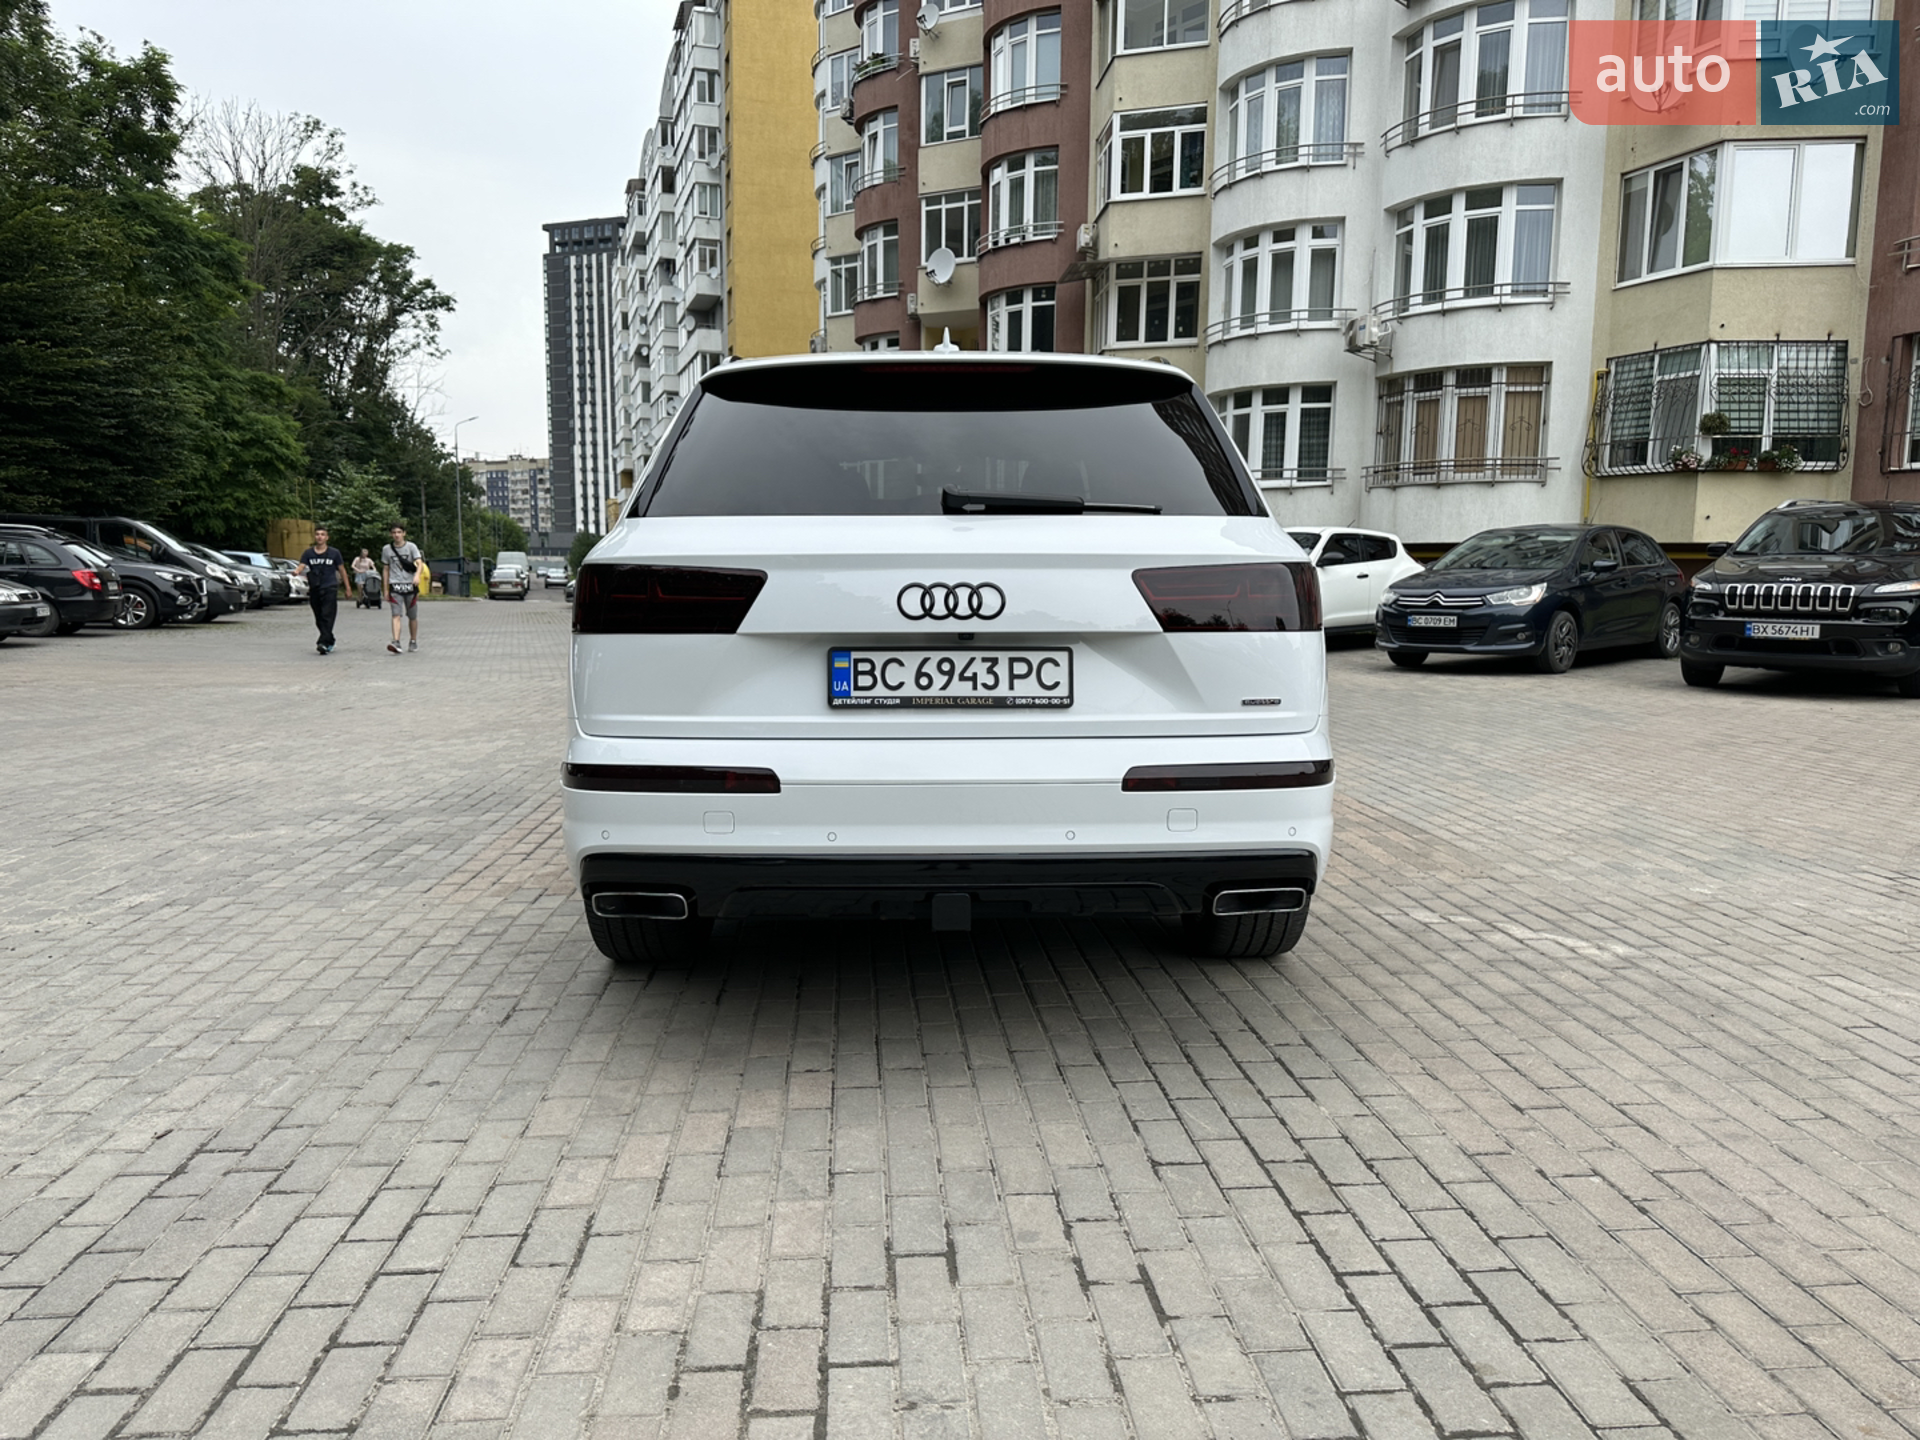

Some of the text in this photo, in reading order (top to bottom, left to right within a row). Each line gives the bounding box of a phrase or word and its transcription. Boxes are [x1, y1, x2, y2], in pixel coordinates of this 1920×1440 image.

[1412, 617, 1456, 626] BC 0709 EM
[1752, 624, 1769, 635] BX
[1771, 625, 1798, 636] 5674
[853, 657, 1061, 691] BC 6943 PC
[833, 681, 849, 691] UA
